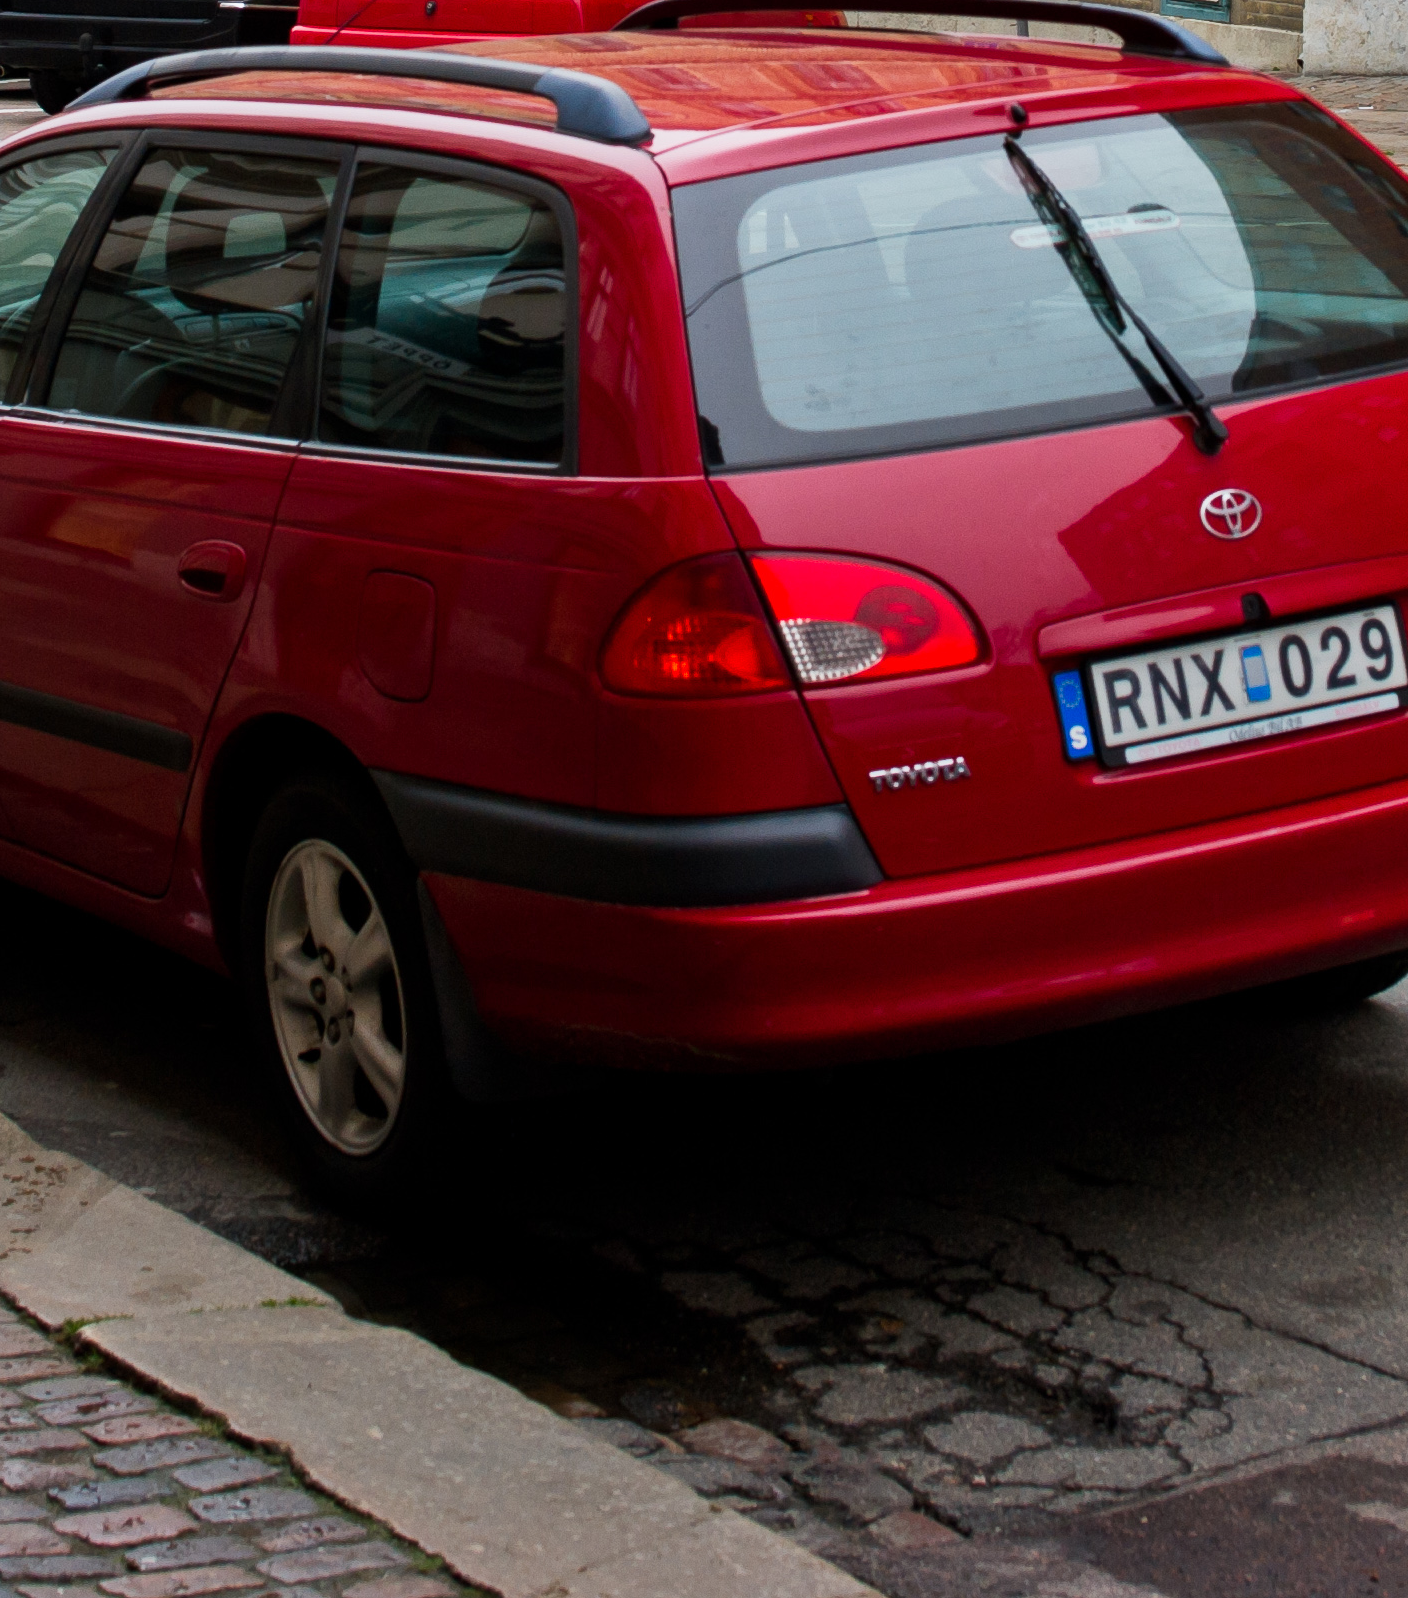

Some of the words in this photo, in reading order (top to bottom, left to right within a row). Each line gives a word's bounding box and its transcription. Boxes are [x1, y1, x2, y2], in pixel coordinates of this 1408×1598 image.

[1102, 649, 1236, 734] RNX
[1278, 618, 1394, 698] 029
[1069, 725, 1088, 750] S
[869, 756, 971, 793] TOYOTA
